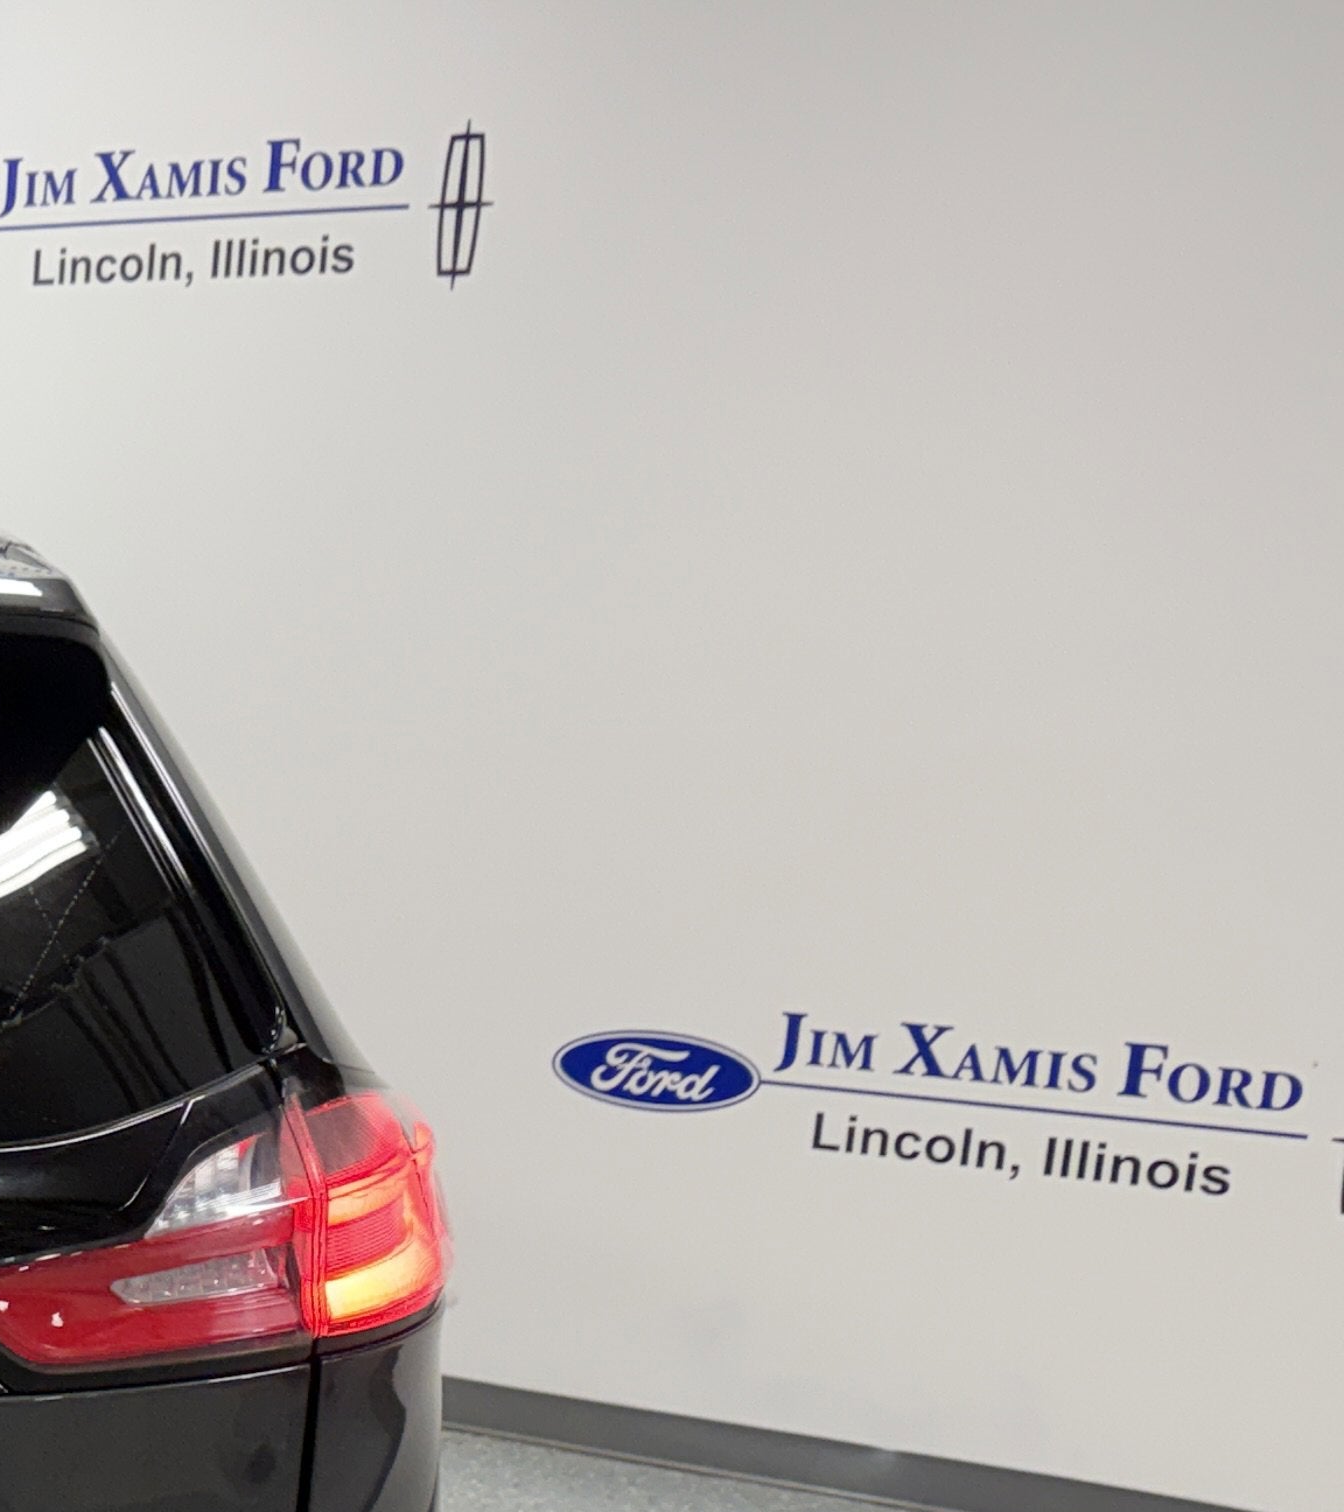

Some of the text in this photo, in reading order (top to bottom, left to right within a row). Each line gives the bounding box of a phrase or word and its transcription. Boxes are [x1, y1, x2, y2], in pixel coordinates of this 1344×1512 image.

[0, 138, 404, 218] JIM XAMIS FORD
[32, 237, 354, 287] Lincoln, Illinois
[591, 1042, 717, 1102] Ford
[774, 1012, 1303, 1111] JIM XAMIS FORD
[811, 1112, 1231, 1196] Lincoln, Illinois
